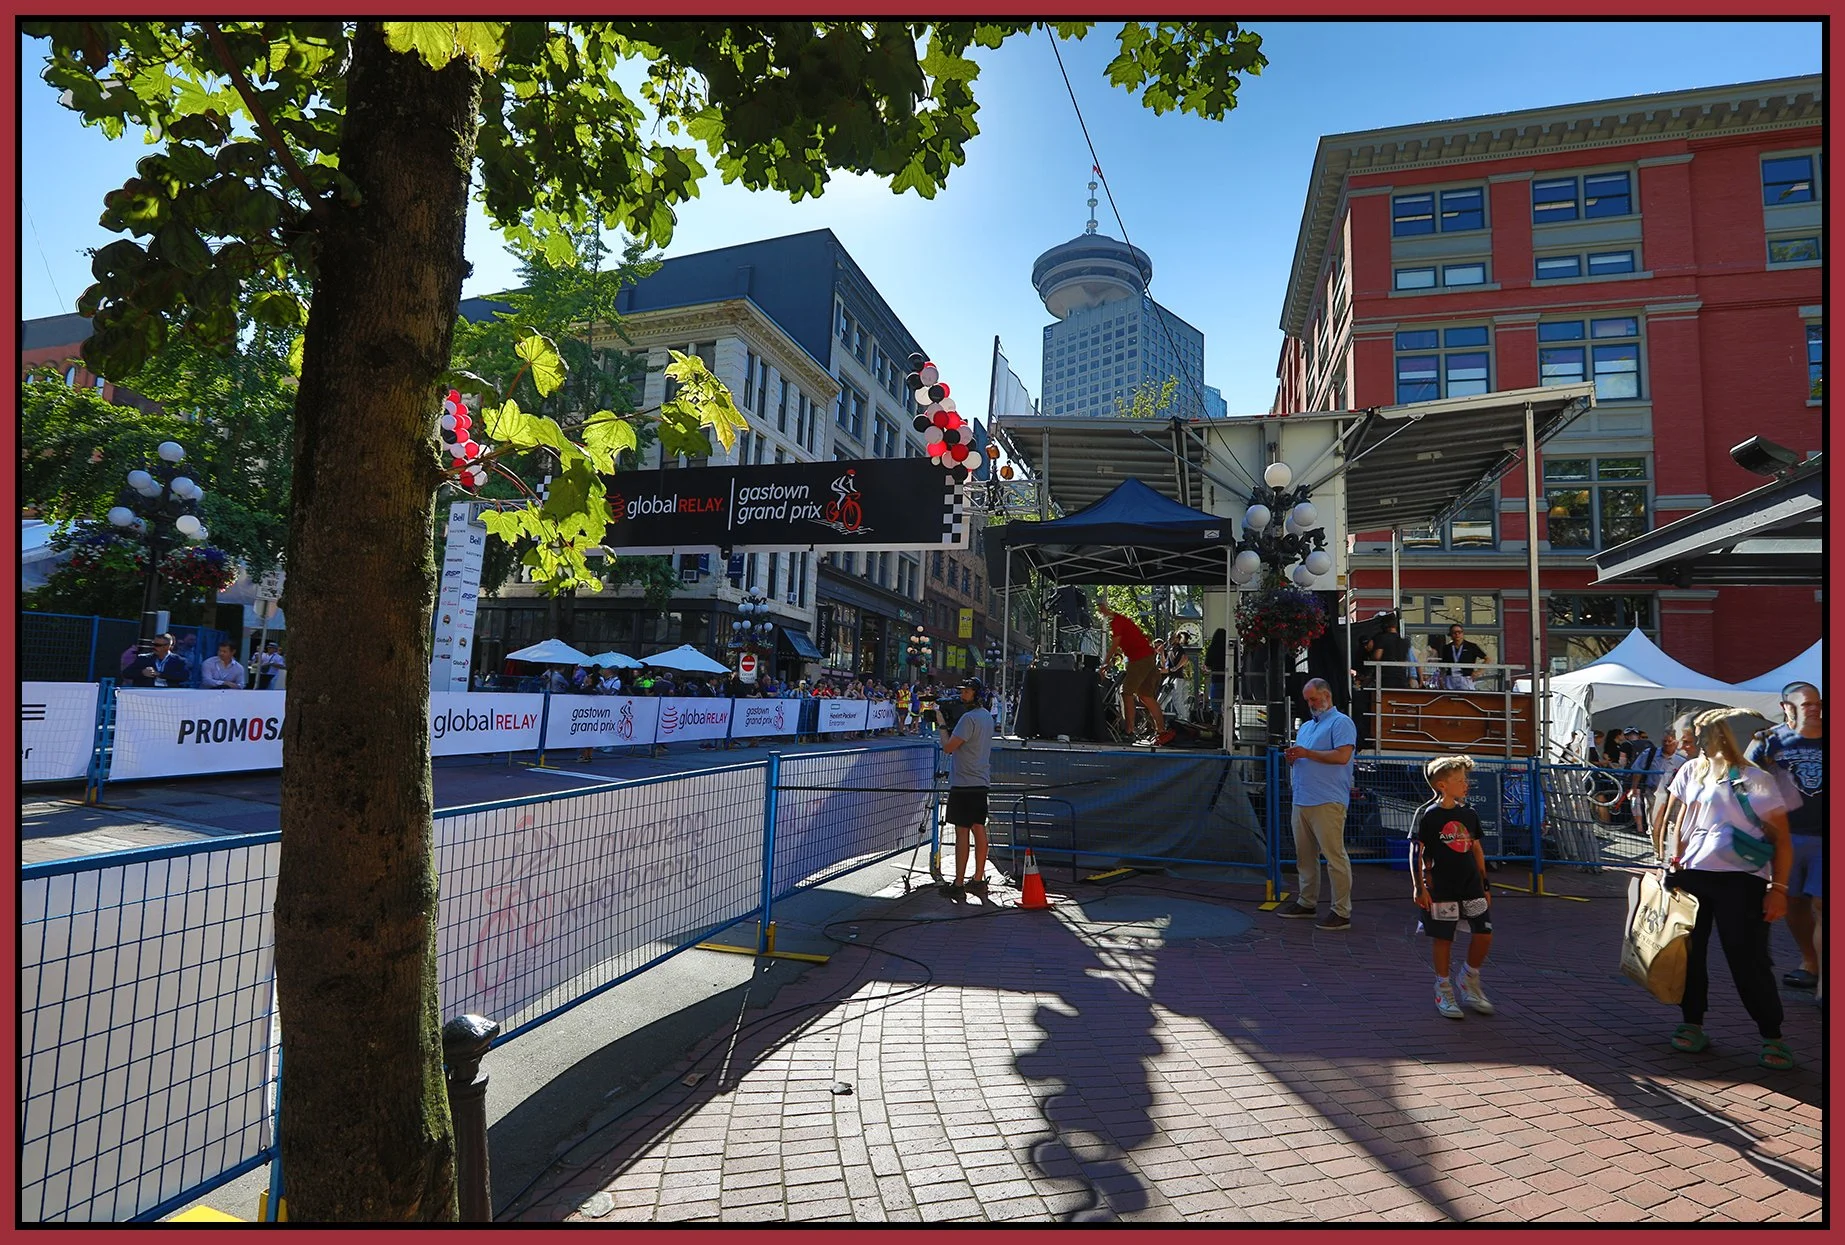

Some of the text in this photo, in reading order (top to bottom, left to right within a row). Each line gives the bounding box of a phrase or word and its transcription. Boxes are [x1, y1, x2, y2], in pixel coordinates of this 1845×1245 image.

[739, 484, 810, 504] gastown
[453, 513, 465, 522] Bell
[737, 501, 822, 525] grand prix
[469, 535, 482, 546] Bell
[571, 706, 611, 721] gastown
[745, 705, 769, 716] gastown
[570, 719, 616, 735] grand prix
[745, 716, 761, 727] grand
